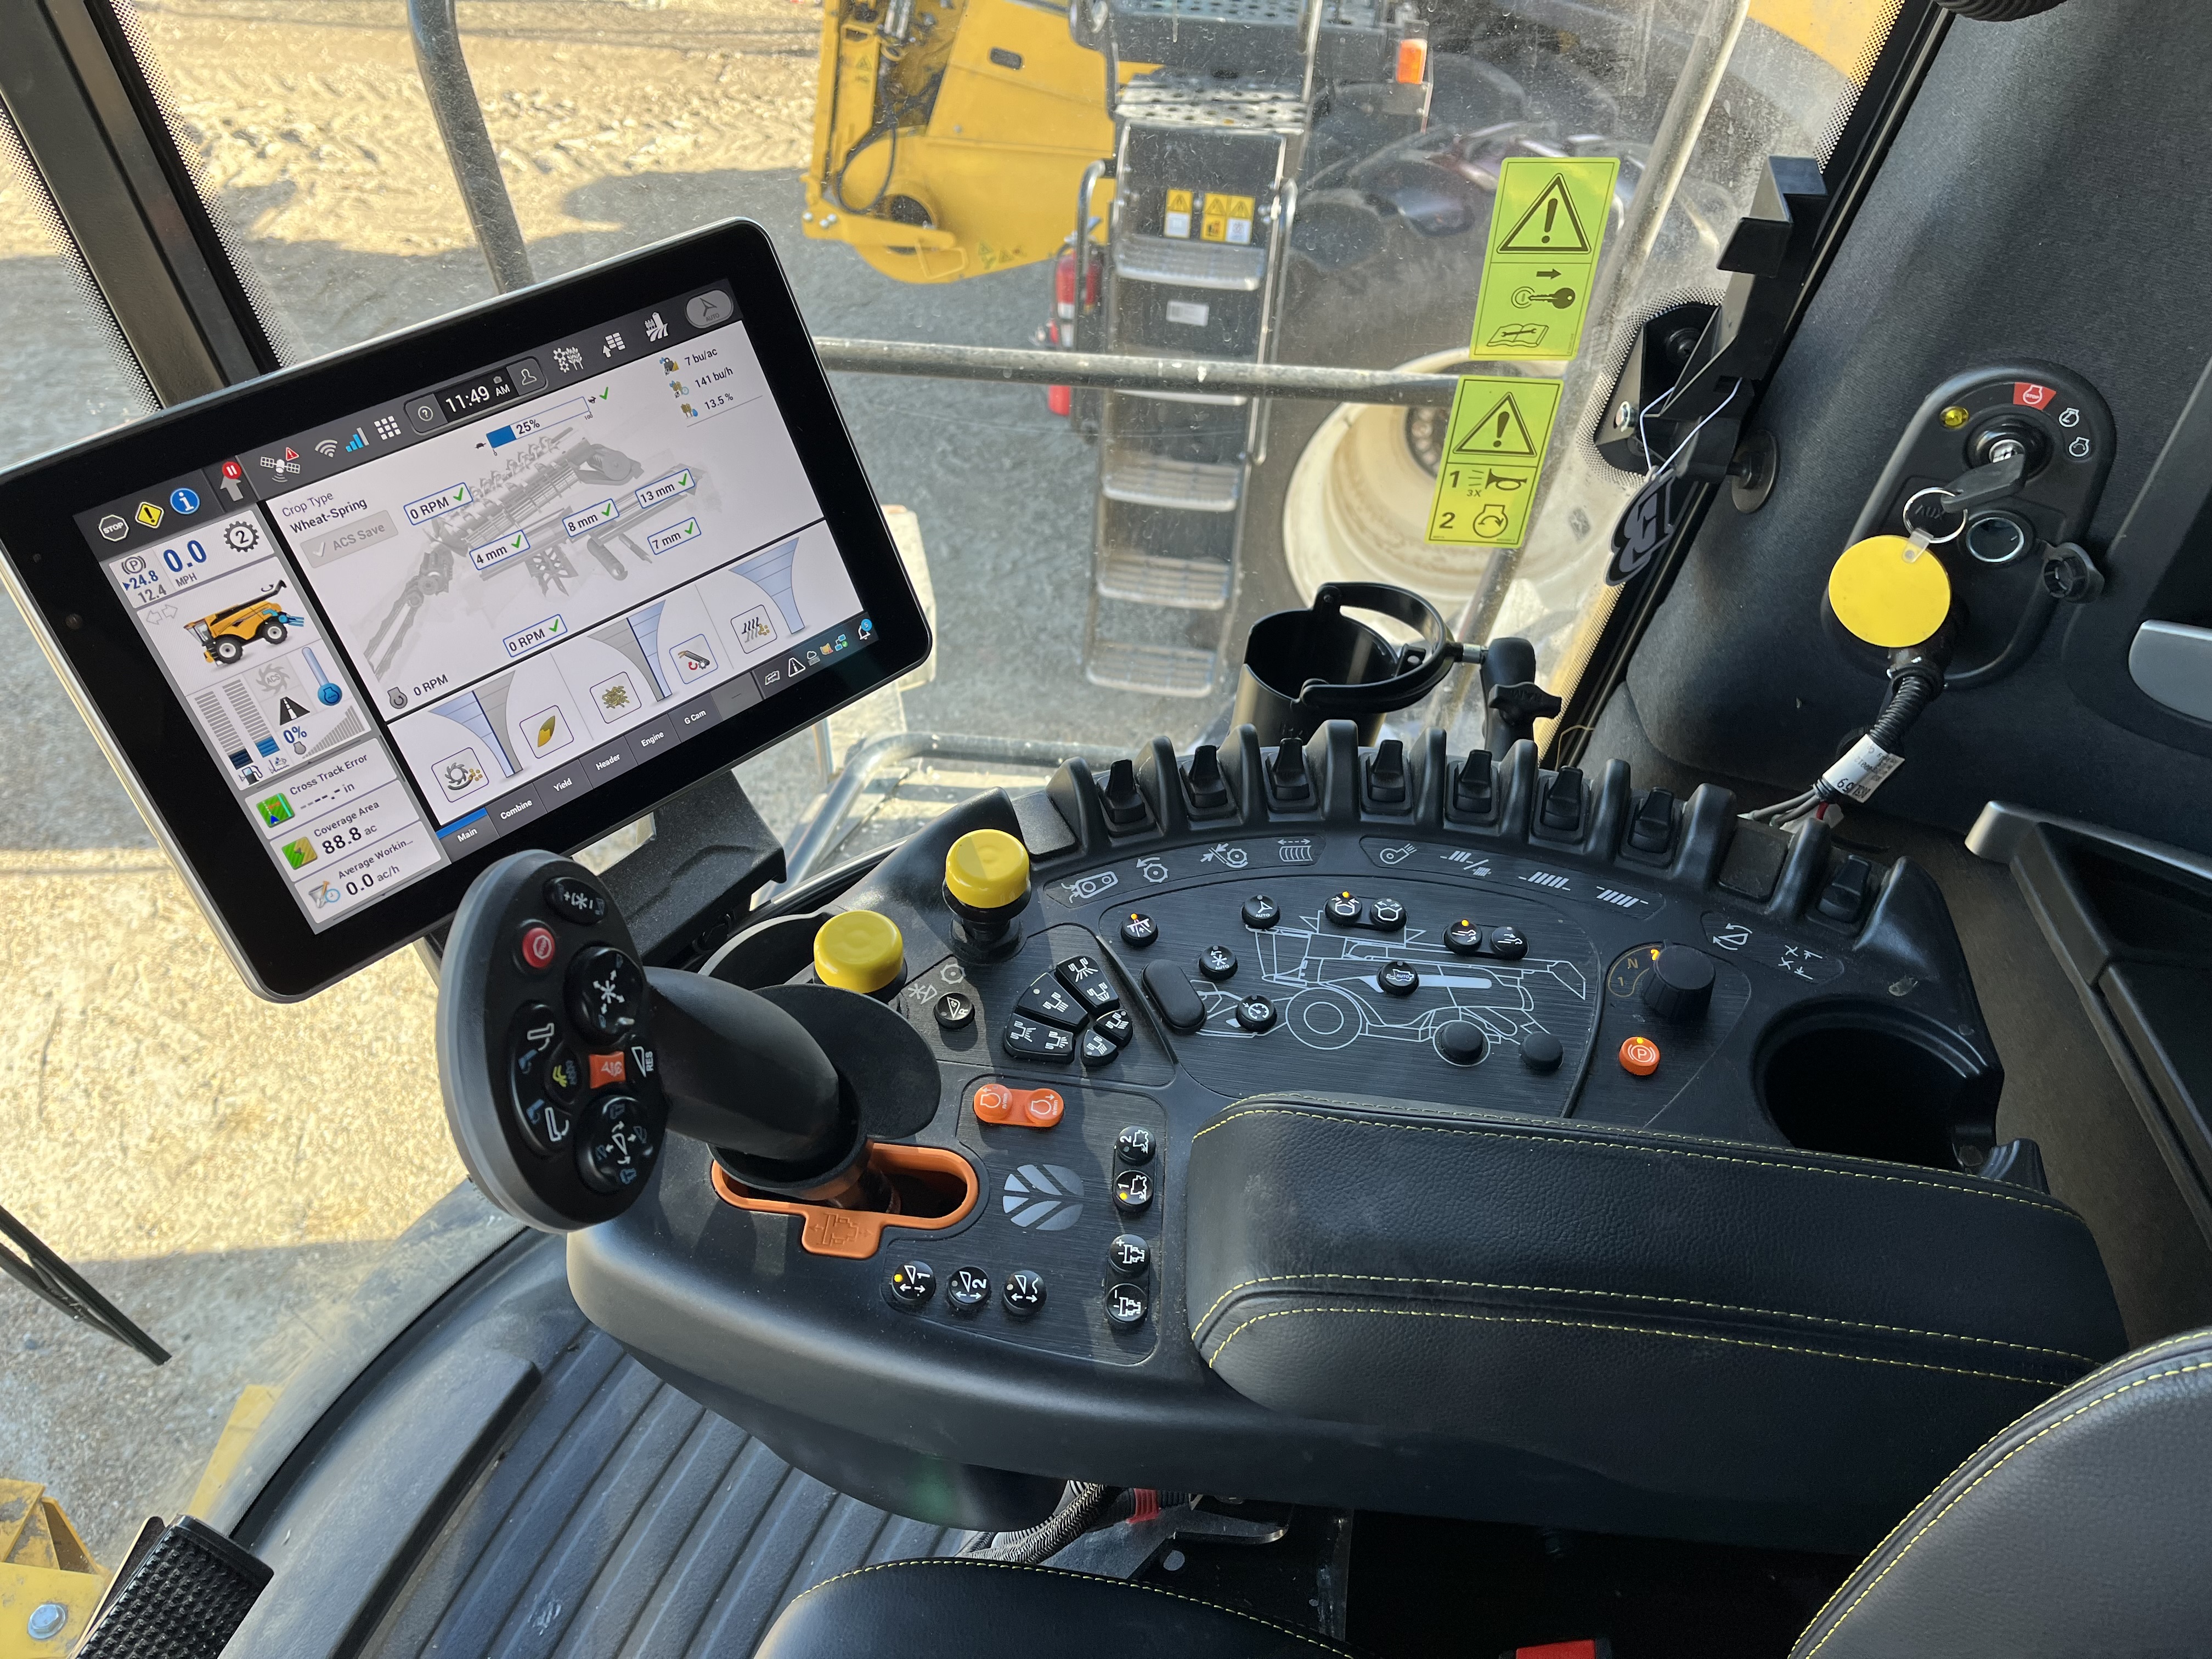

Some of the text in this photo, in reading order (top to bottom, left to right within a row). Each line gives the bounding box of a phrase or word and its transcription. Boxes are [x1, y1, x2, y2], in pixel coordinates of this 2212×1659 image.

[706, 312, 720, 322] AUTO
[684, 349, 718, 366] 7 bu/ac
[695, 367, 733, 387] 141 bu/h
[445, 384, 510, 413] 11:49 AM
[704, 396, 724, 410] 13.5
[516, 419, 540, 435] 25%
[1448, 471, 1460, 488] 1
[640, 483, 675, 504] 13 mm
[1466, 489, 1482, 498] 3X
[283, 492, 334, 517] Crop Type
[410, 496, 449, 520] 0 RPM
[290, 498, 368, 534] Wheat-Spring
[568, 514, 599, 532] 8 mm
[1439, 512, 1455, 529] 2
[103, 520, 124, 535] STOP
[332, 522, 386, 551] ACS Save
[238, 531, 249, 544] 2
[651, 532, 681, 550] 7 mm
[163, 540, 207, 573] 0.0
[476, 545, 507, 565] 4 mm
[129, 569, 159, 590] 24.8
[175, 572, 198, 588] MPH
[138, 584, 167, 603] 12.4
[509, 628, 545, 652] 0 RPM
[266, 672, 280, 685] ACS
[413, 674, 449, 697] 0 RPM
[684, 709, 707, 725] G Cam
[283, 725, 307, 744] 0%
[641, 730, 665, 747] Engine
[595, 753, 621, 771] Header
[290, 753, 369, 796] Cross Track Error
[344, 782, 356, 794] in
[553, 777, 573, 793] Yield
[313, 800, 380, 838] Coverage Area
[500, 799, 533, 821] Combine
[321, 823, 377, 855] 88.8 ac
[457, 827, 478, 843] Main
[338, 856, 375, 879] Average
[345, 864, 400, 896] 0.0 ac/h
[1627, 958, 1639, 969] N
[645, 1051, 654, 1071] RES
[1637, 1048, 1647, 1059] P
[1119, 1135, 1132, 1143] 2
[972, 1278, 987, 1289] 2
